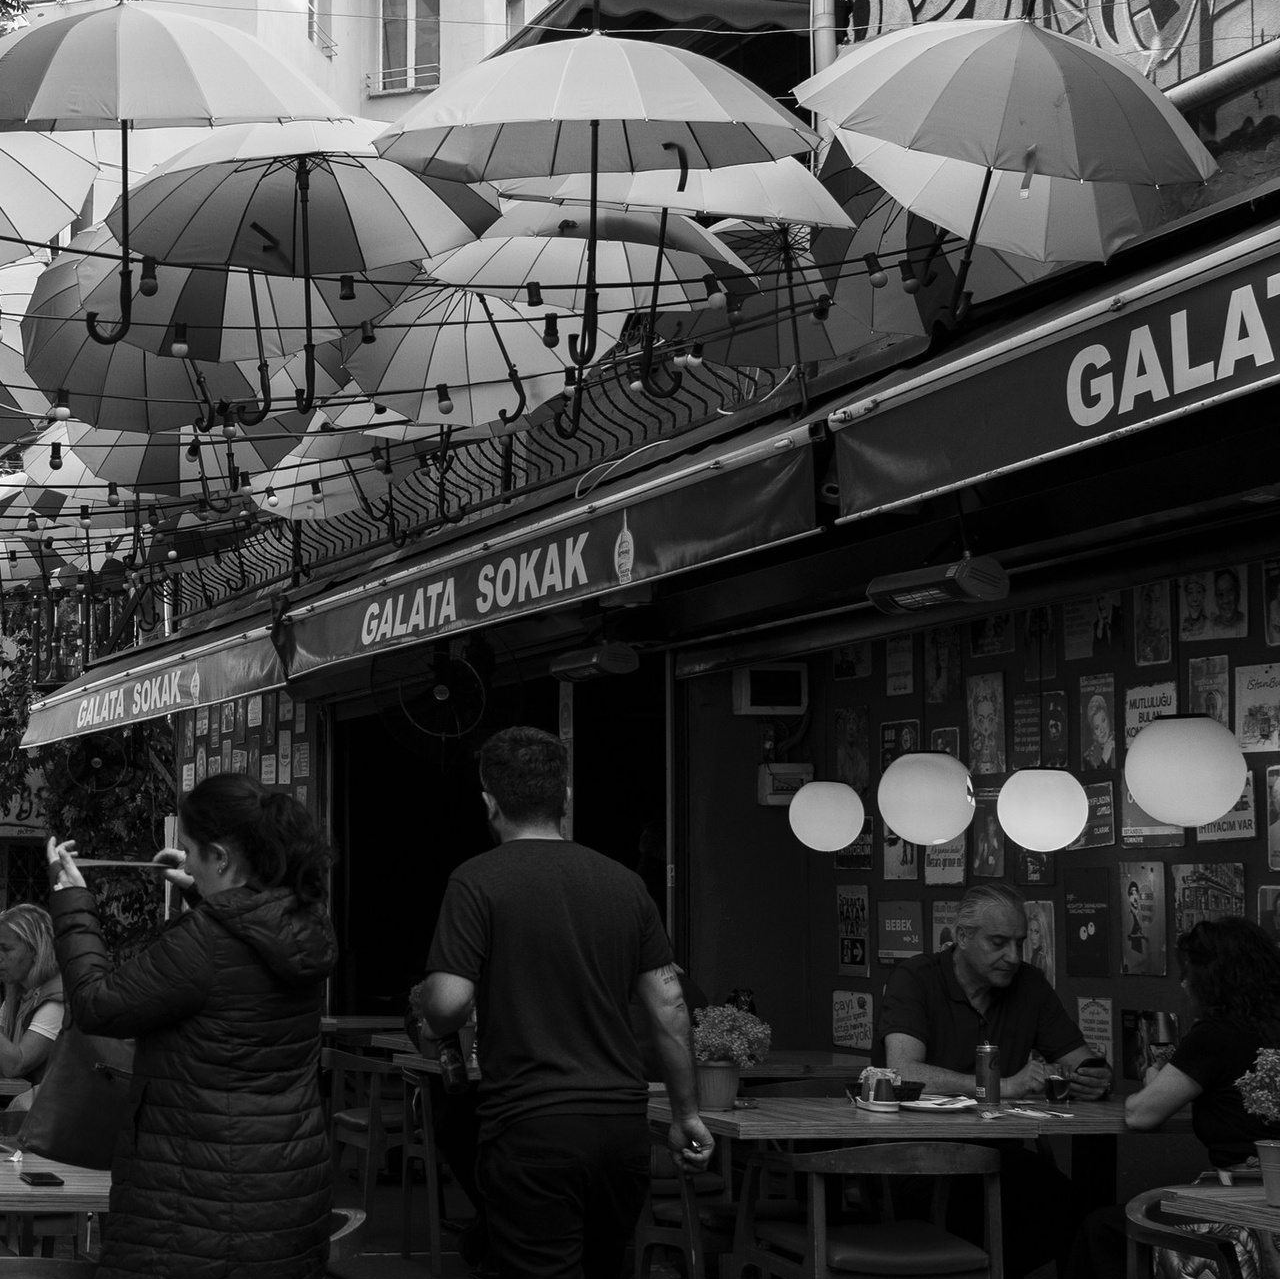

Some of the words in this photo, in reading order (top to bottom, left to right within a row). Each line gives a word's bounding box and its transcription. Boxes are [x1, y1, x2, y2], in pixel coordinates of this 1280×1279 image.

[1066, 272, 1280, 427] GALA
[361, 576, 457, 647] GALATA
[475, 532, 590, 615] SOKAK
[76, 687, 124, 729] GALATA
[131, 669, 181, 714] SOKAK
[1128, 692, 1172, 710] MUTLULUĞU
[1237, 818, 1253, 830] VAR
[885, 919, 913, 931] BEBEK
[911, 934, 919, 944] 34
